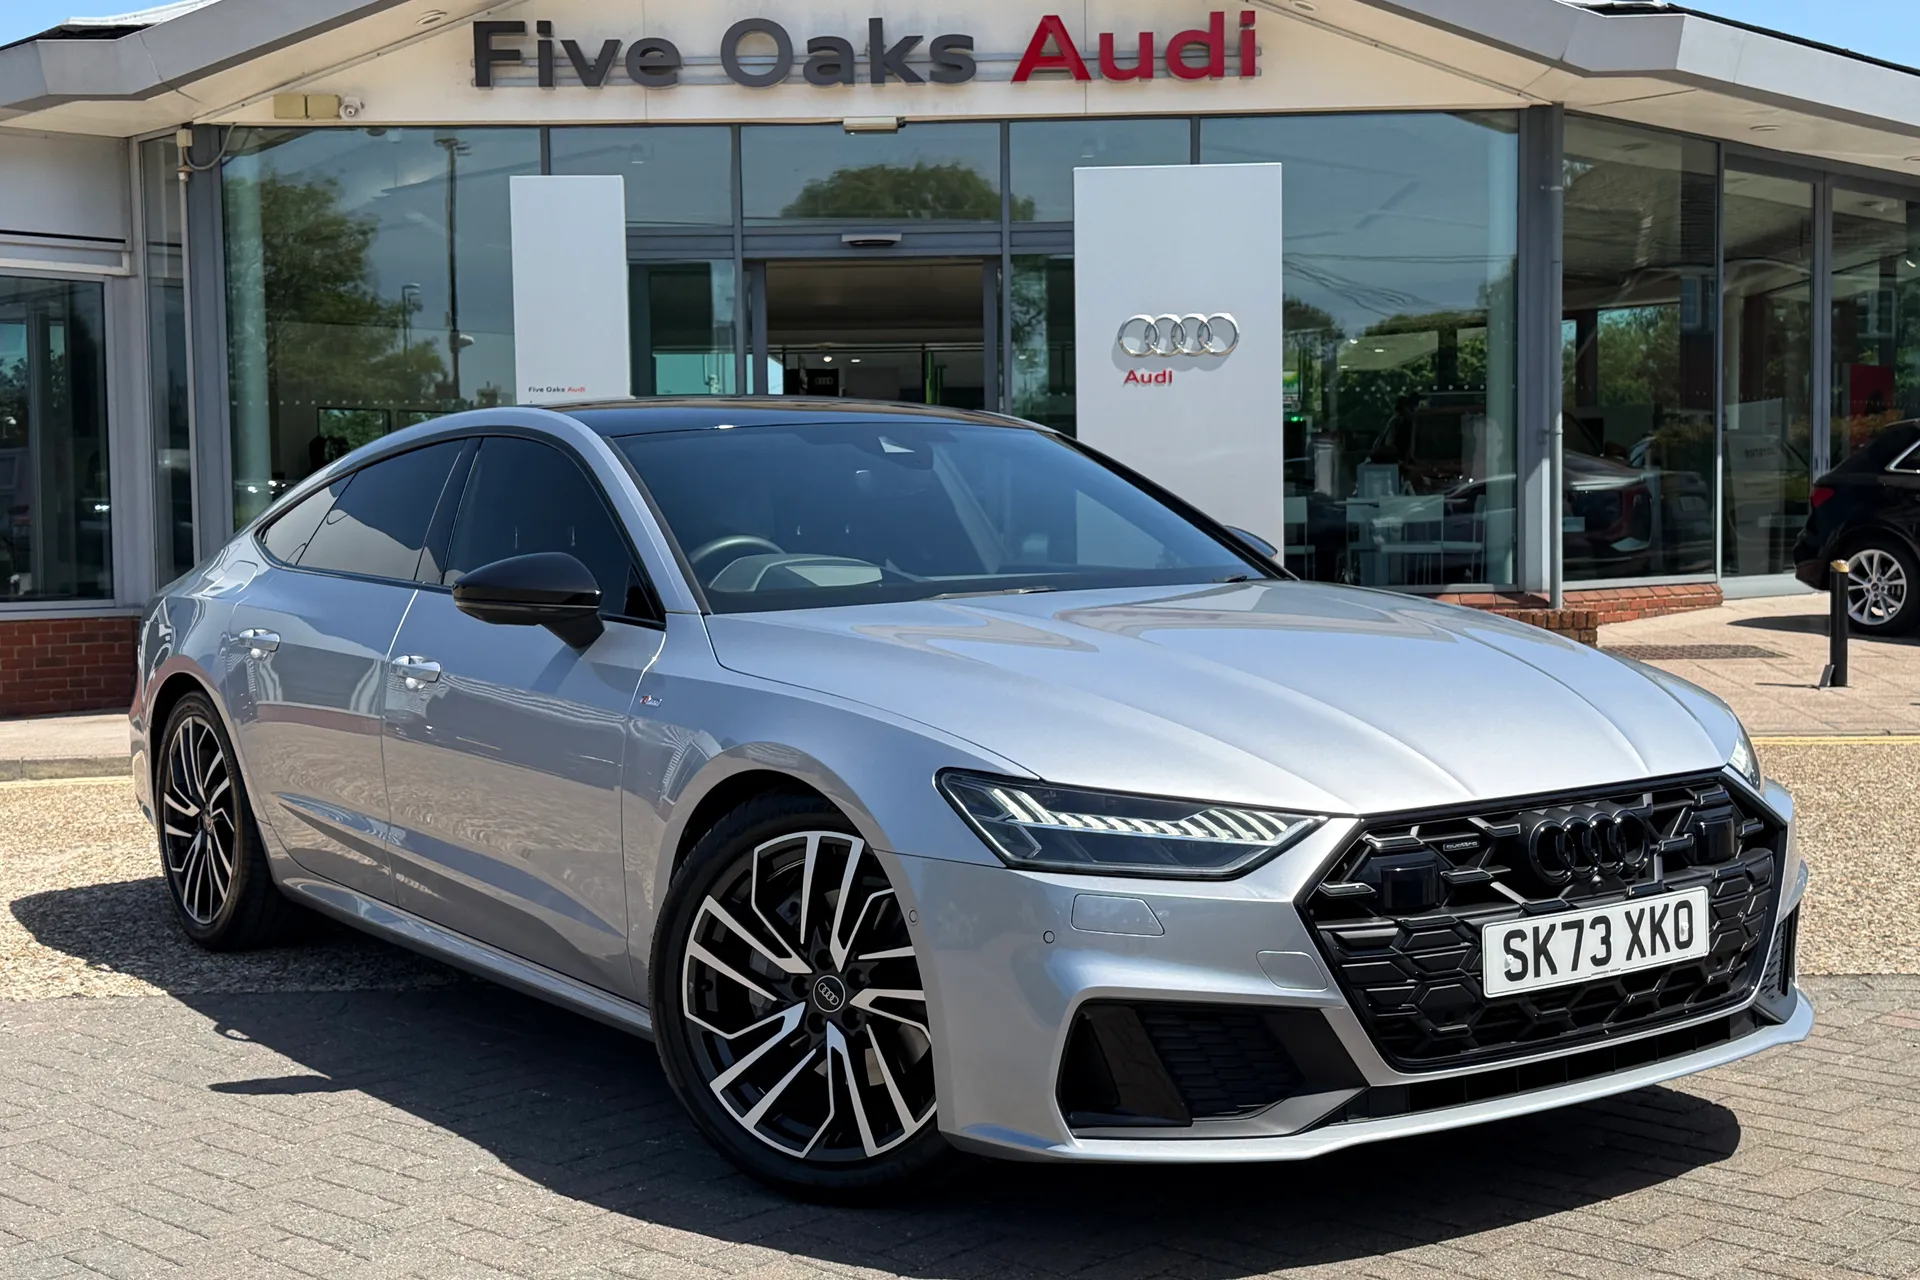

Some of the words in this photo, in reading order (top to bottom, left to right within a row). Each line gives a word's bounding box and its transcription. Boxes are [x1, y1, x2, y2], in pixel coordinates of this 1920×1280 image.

[473, 20, 682, 89] Five
[720, 18, 977, 87] Oaks
[1011, 10, 1256, 83] Audi
[1124, 369, 1173, 384] Audi
[1503, 915, 1612, 982] SK73
[1624, 899, 1694, 961] XKO
